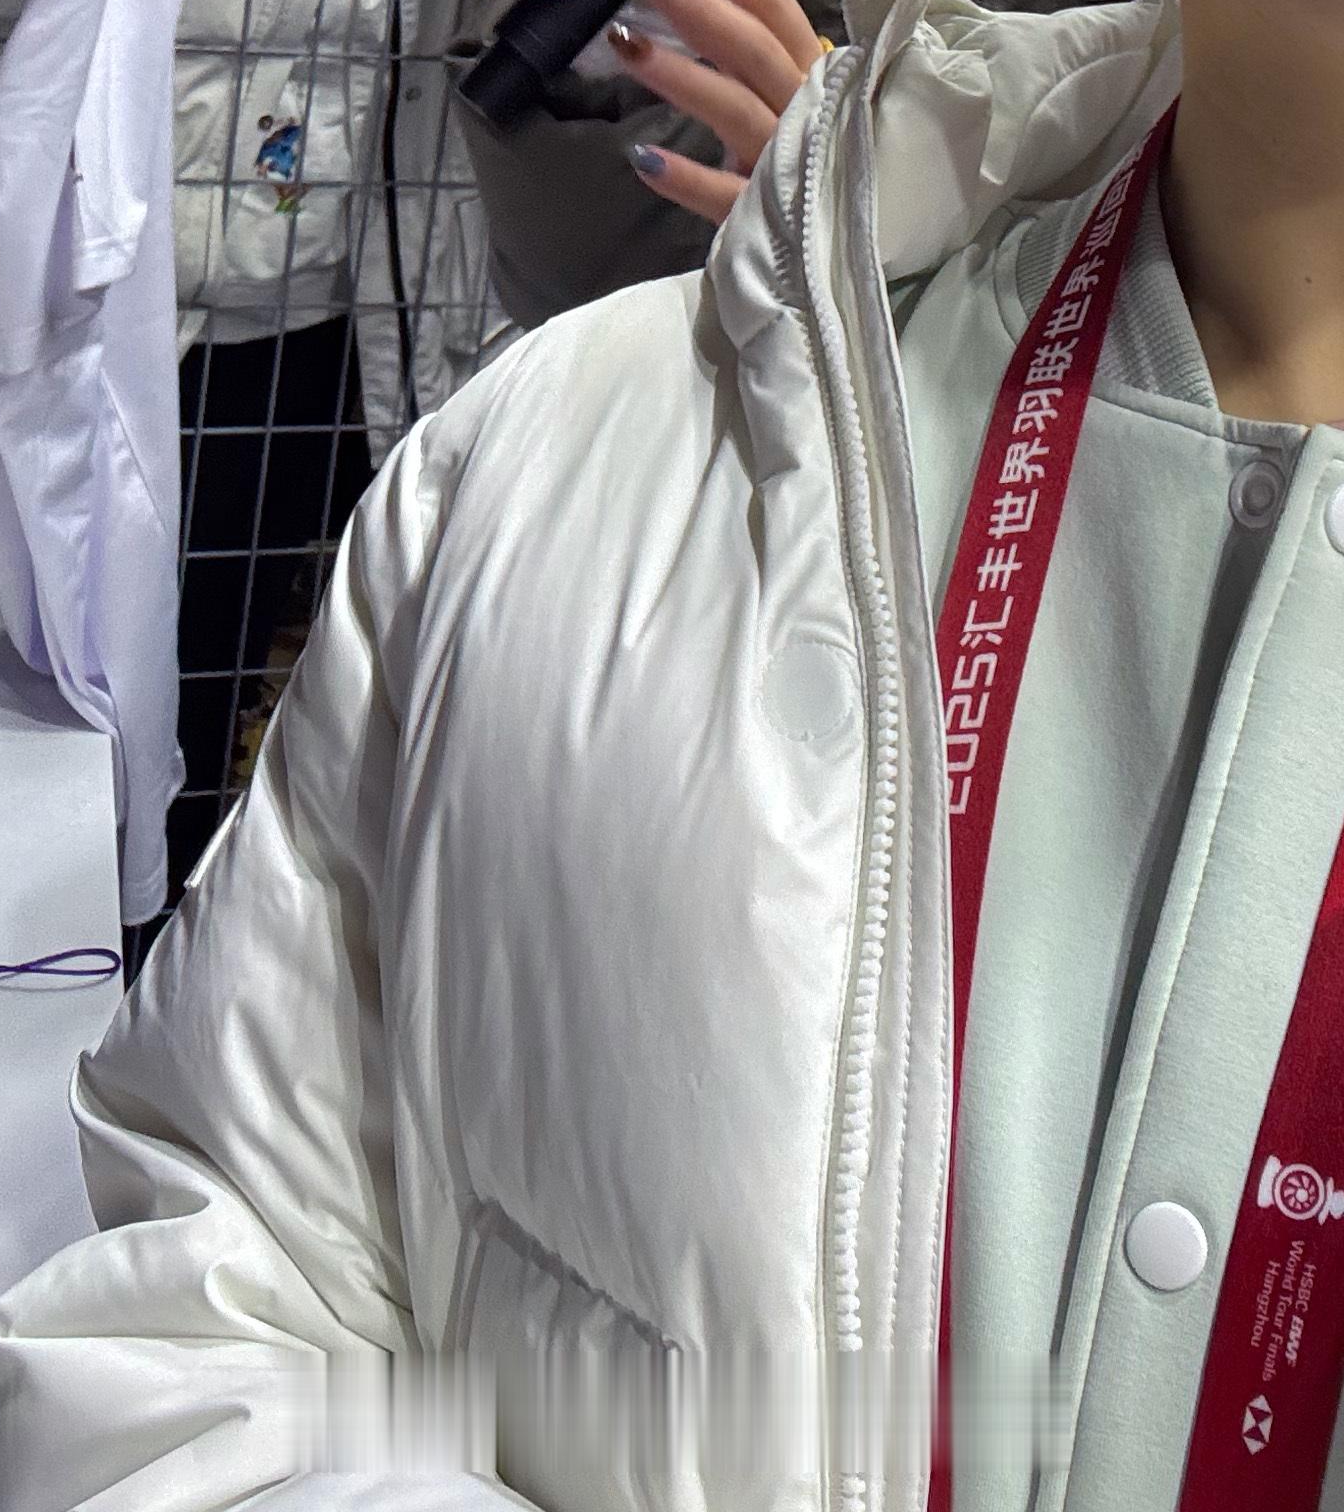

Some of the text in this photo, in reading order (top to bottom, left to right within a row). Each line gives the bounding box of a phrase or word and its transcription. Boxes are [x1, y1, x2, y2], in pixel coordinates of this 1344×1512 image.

[1250, 1260, 1281, 1348] Hangzhou
[1262, 1239, 1305, 1382] World Tour Finals
[1295, 1263, 1317, 1313] HSBC
